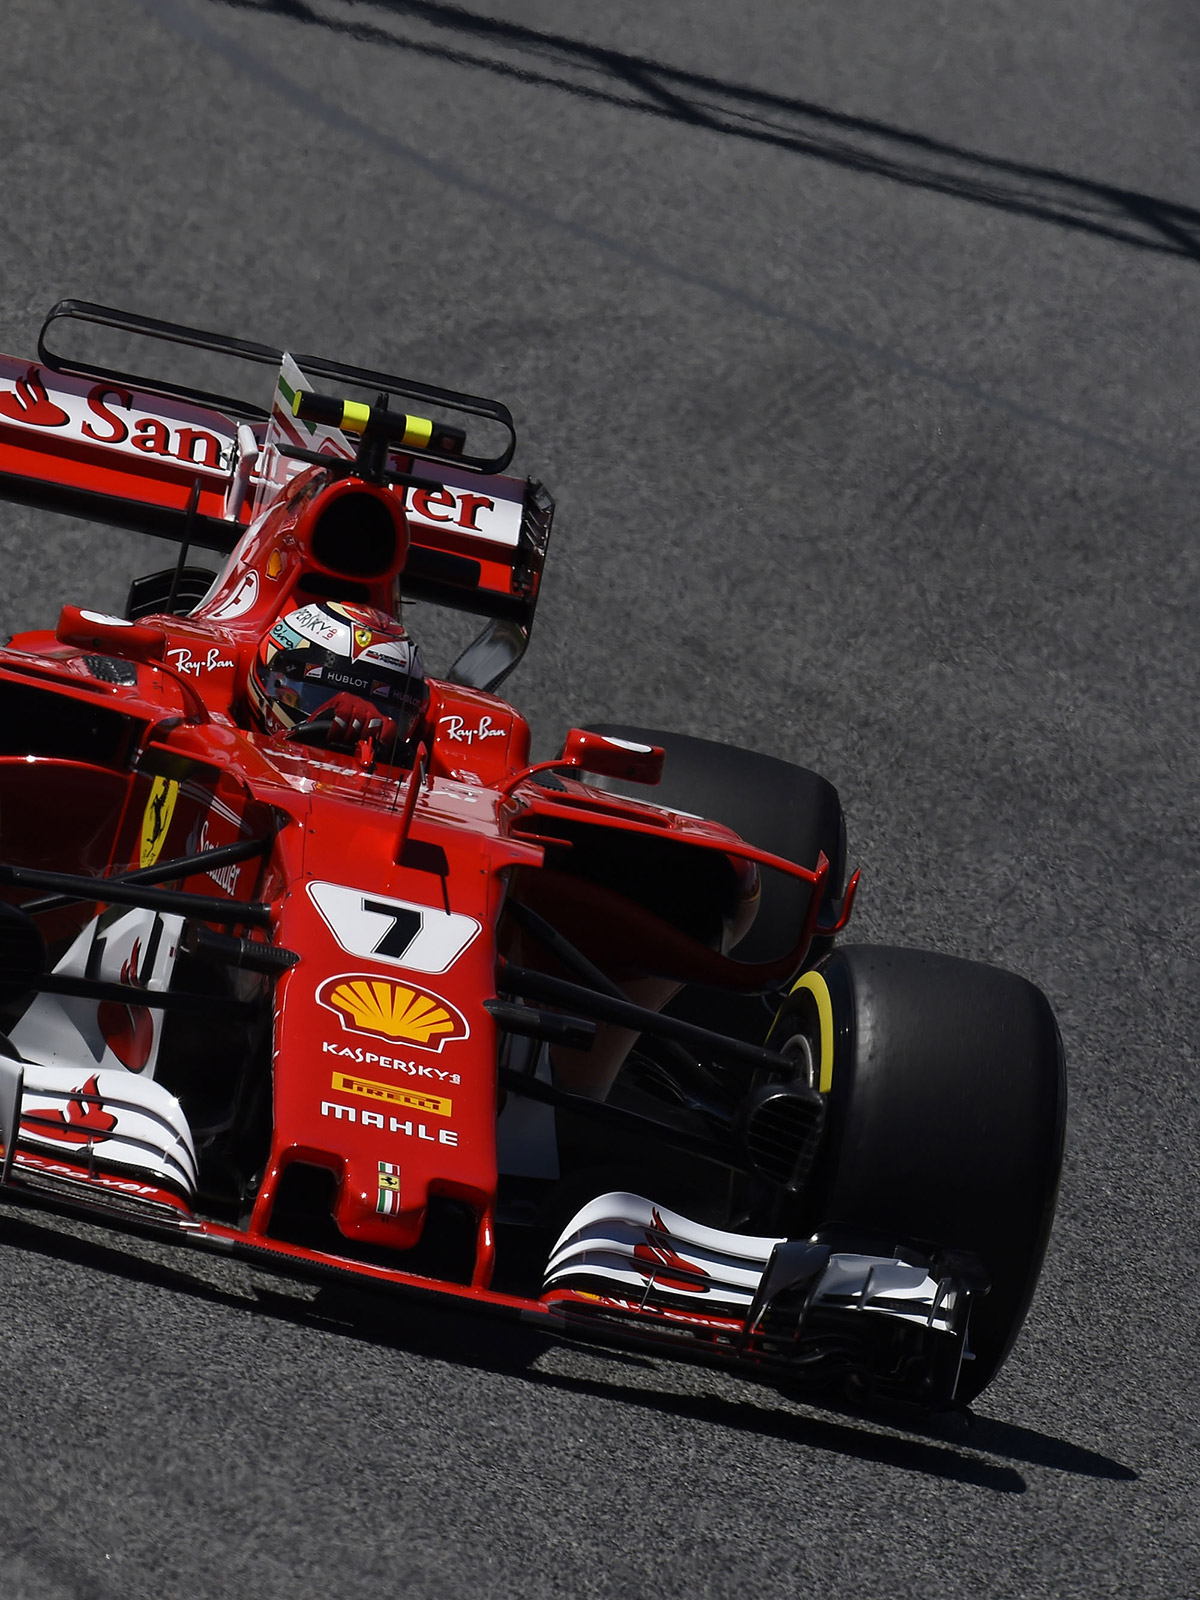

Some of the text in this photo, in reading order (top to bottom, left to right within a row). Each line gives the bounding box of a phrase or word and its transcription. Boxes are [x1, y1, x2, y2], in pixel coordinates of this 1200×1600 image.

[81, 384, 494, 532] Saner
[327, 672, 369, 689] HUBLOT
[360, 897, 424, 960] 7
[322, 1041, 449, 1081] KASPERSKY
[341, 1077, 442, 1111] PIRELLI
[321, 1100, 459, 1147] MAHLE
